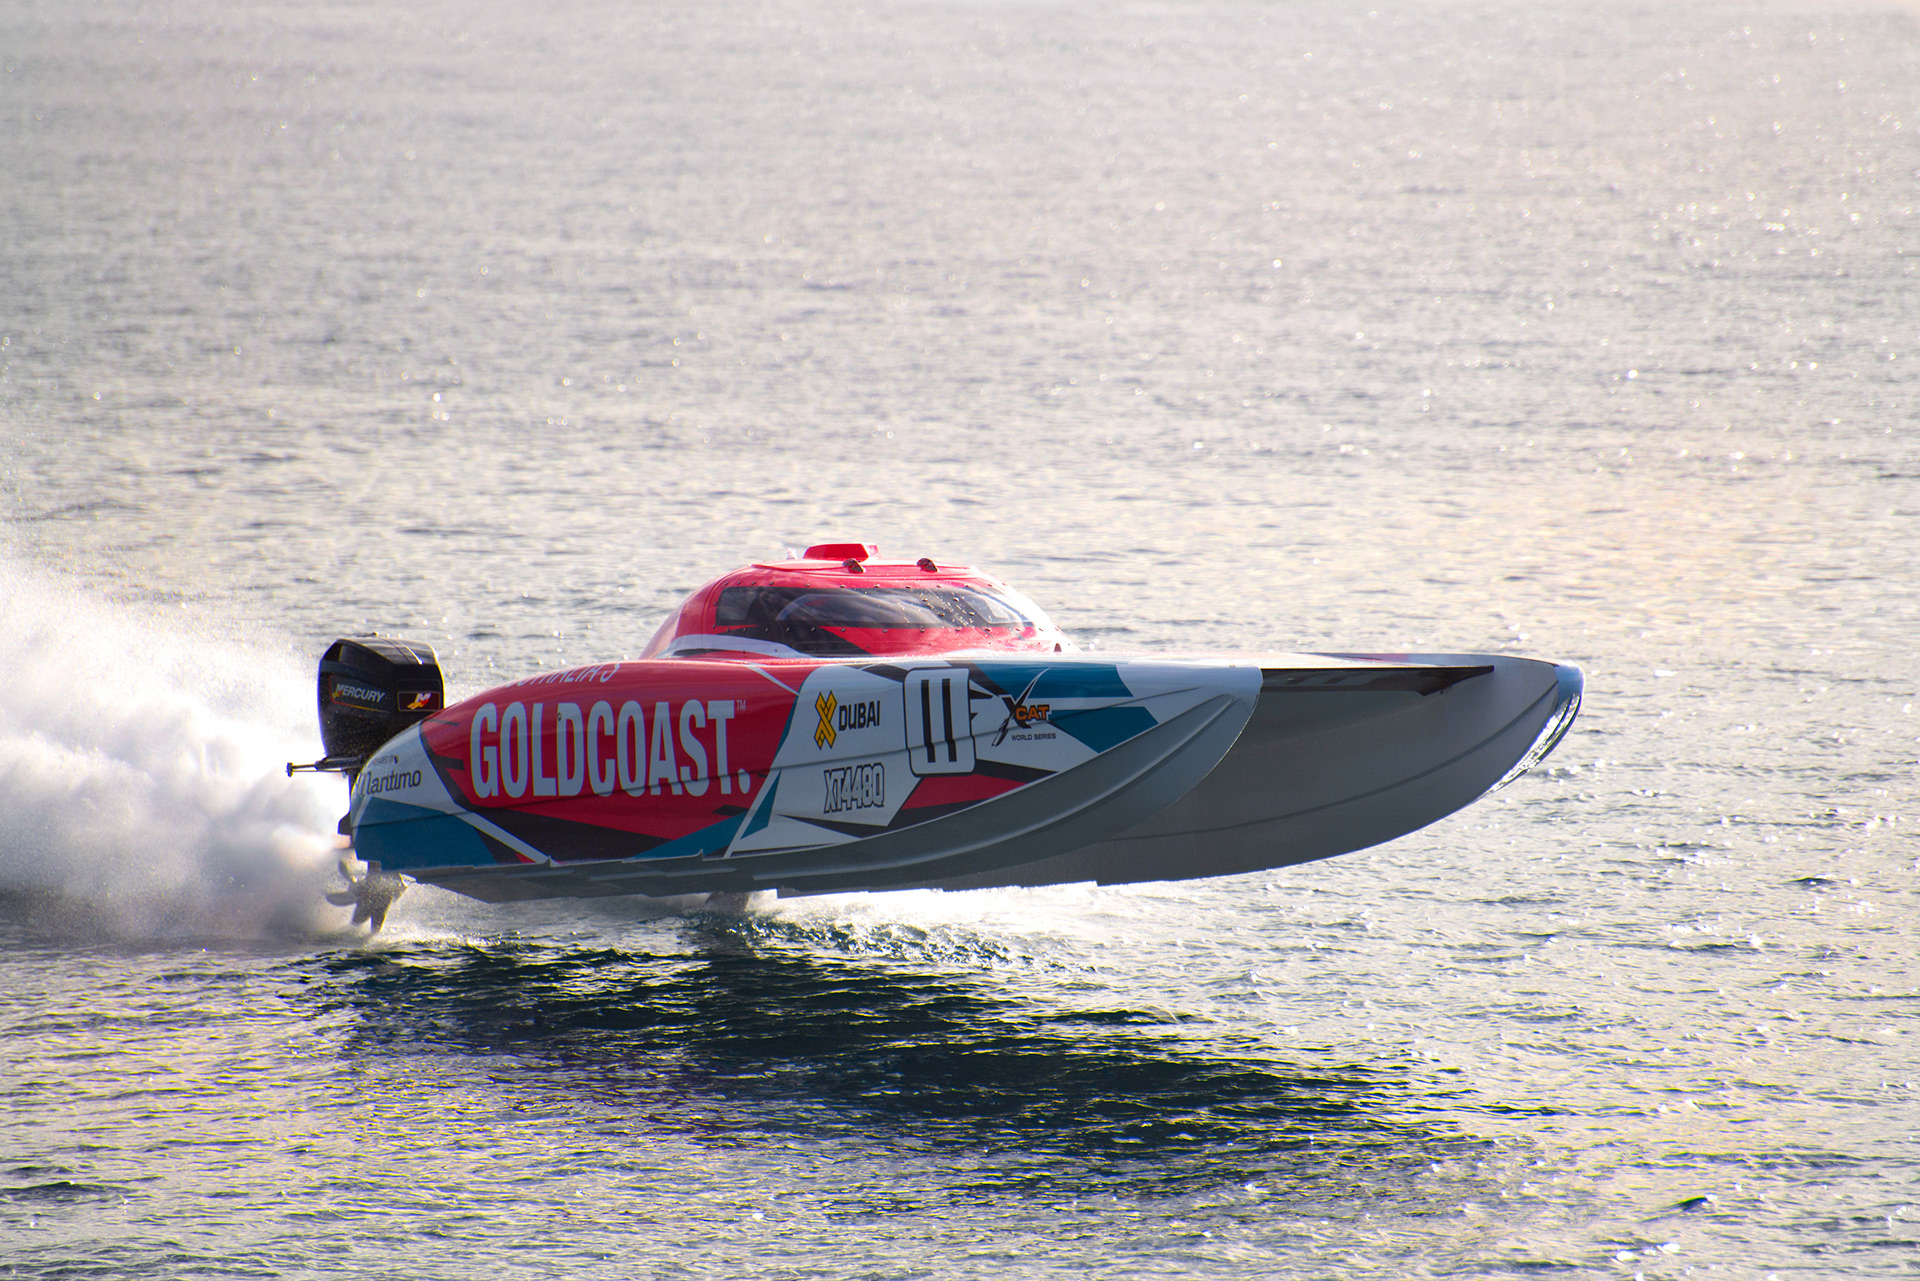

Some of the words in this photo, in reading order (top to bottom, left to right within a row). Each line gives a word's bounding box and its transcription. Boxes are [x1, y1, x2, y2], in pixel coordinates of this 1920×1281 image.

[334, 683, 385, 703] MERCURY
[838, 700, 881, 732] DUBAI
[470, 699, 750, 799] GOLDCOAST.
[1034, 732, 1057, 740] SERIES
